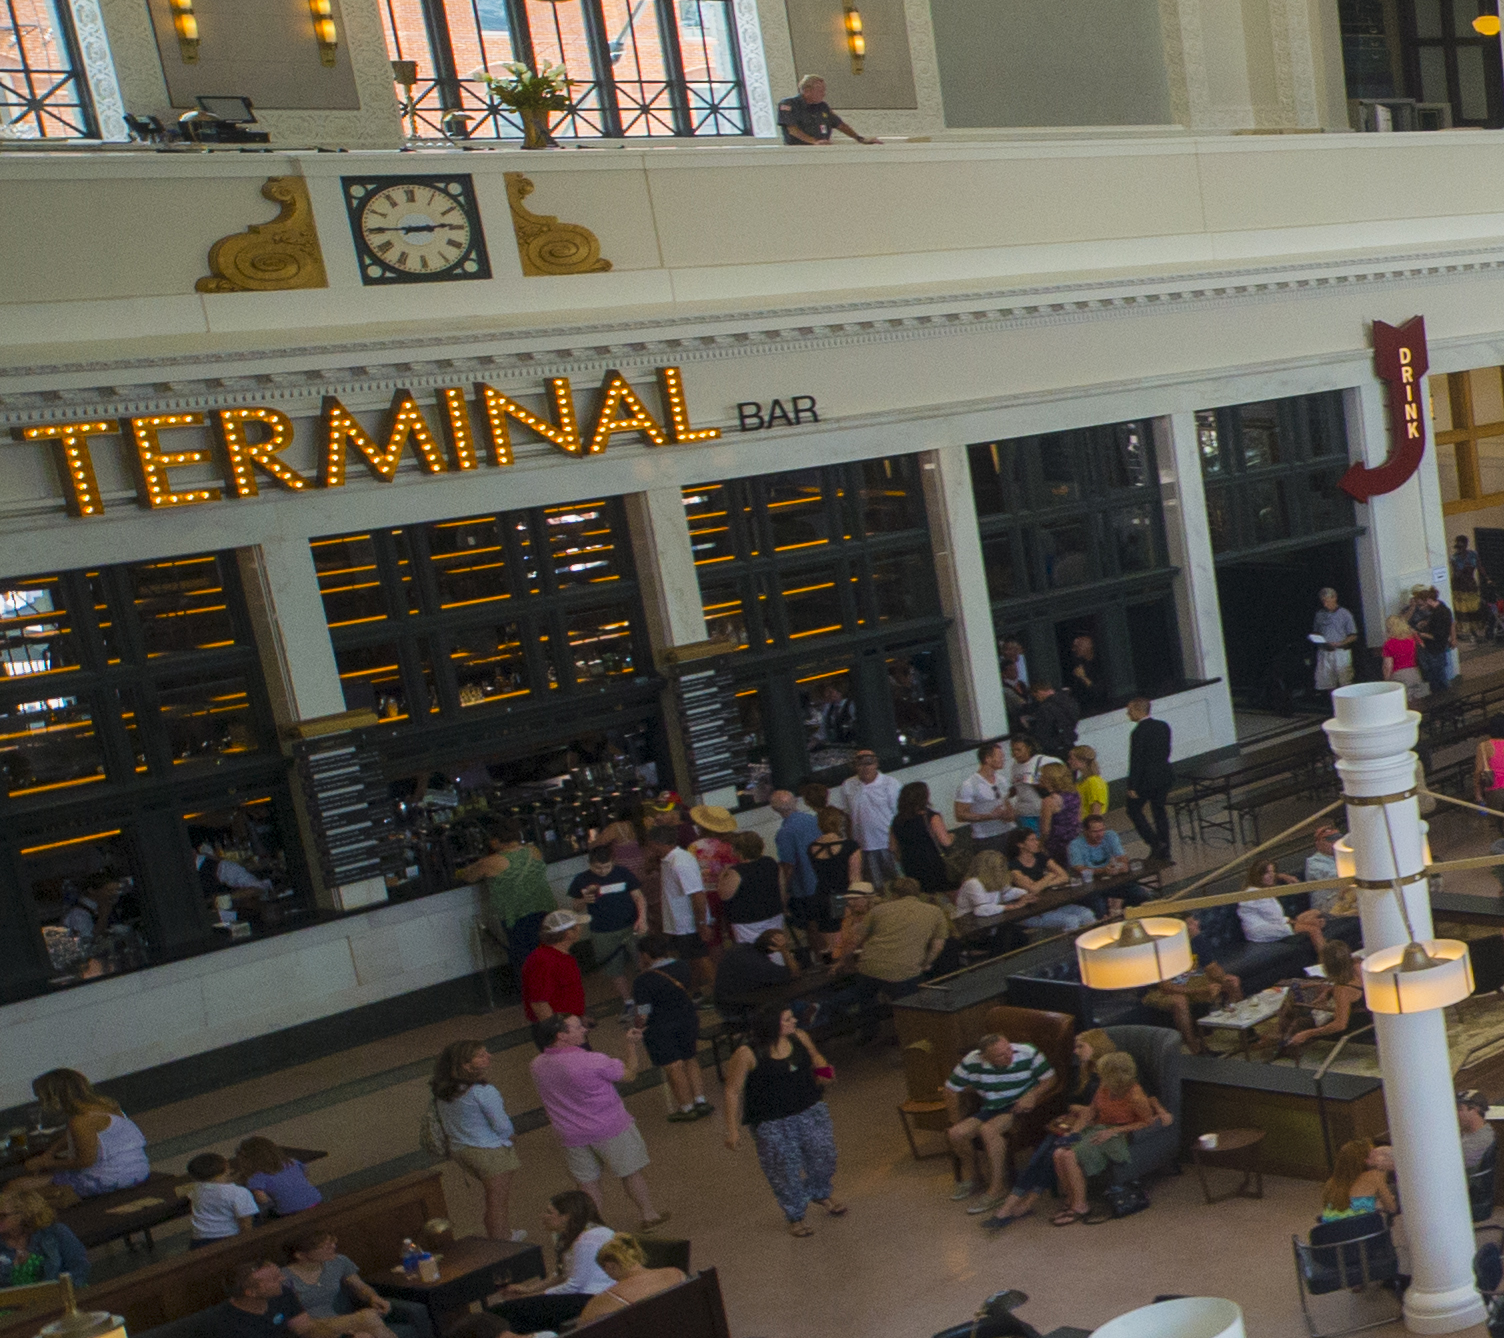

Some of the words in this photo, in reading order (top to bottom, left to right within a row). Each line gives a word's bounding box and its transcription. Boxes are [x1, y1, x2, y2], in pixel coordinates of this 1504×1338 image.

[10, 366, 722, 518] TERMINAL
[738, 394, 821, 432] BAR
[1399, 347, 1419, 439] DRINK
